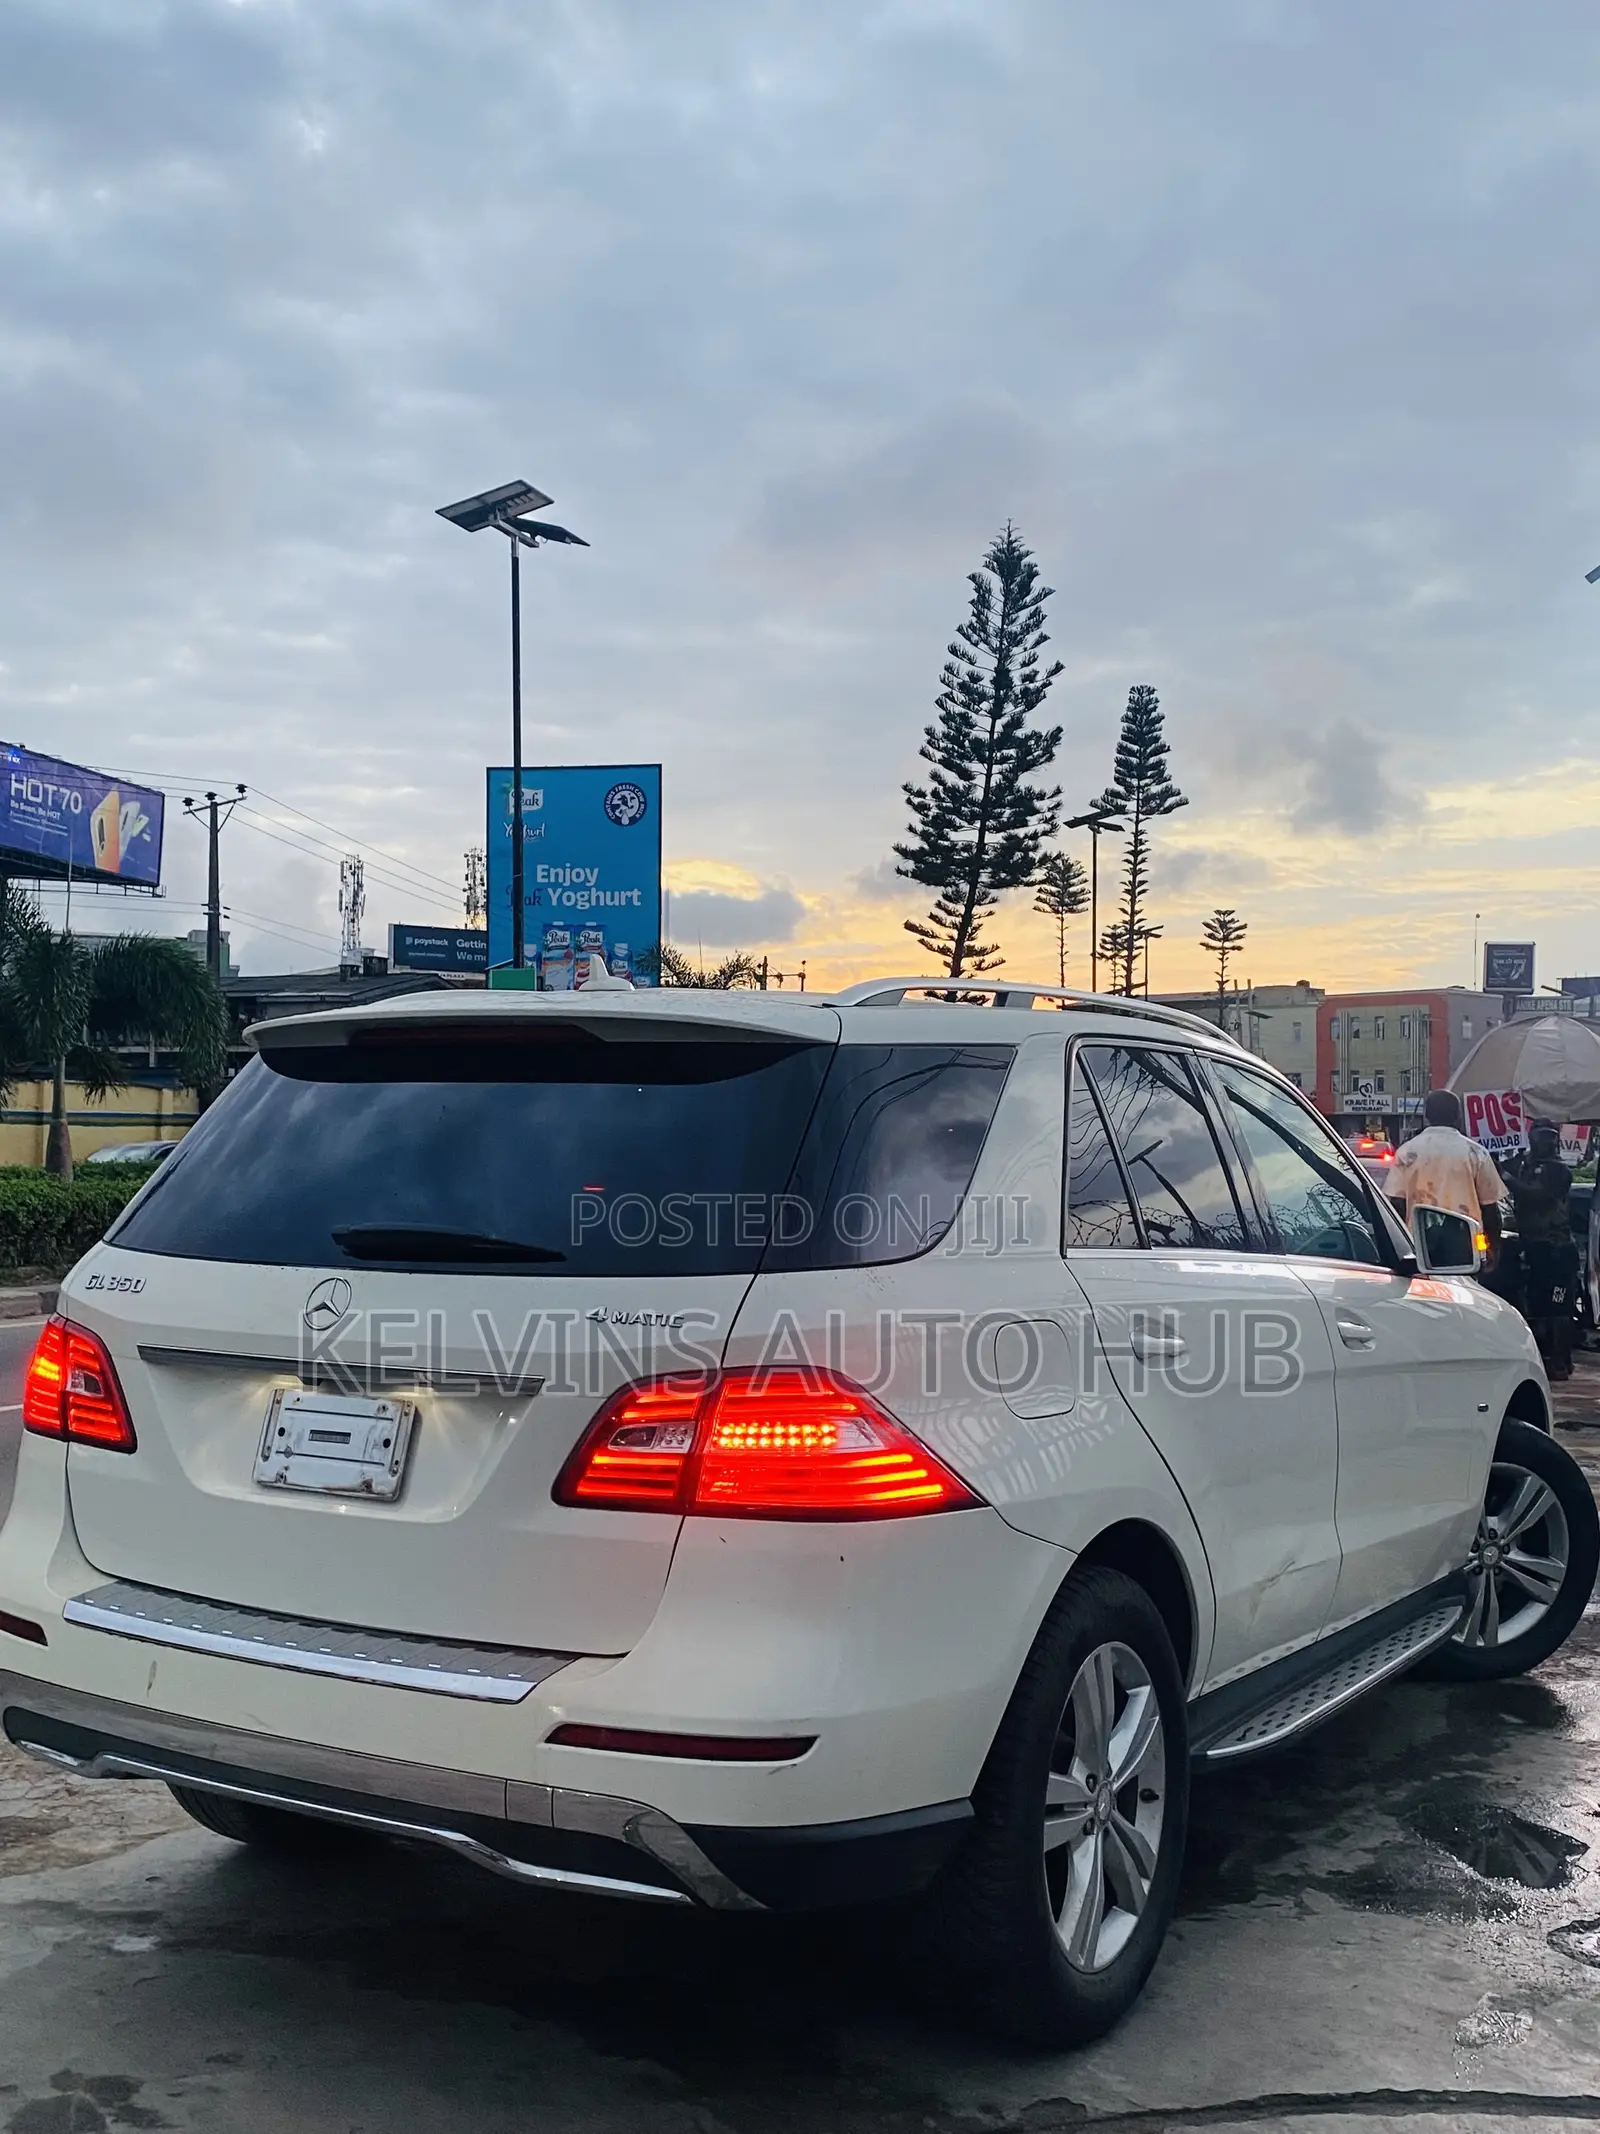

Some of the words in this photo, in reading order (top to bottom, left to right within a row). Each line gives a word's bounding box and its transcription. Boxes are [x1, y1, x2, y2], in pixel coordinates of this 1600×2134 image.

[11, 773, 58, 807] HOT
[47, 809, 61, 820] HOT
[536, 863, 599, 887] Enjoy
[547, 887, 642, 910] Yoghurt
[456, 951, 473, 960] We
[1467, 1092, 1522, 1137] POS
